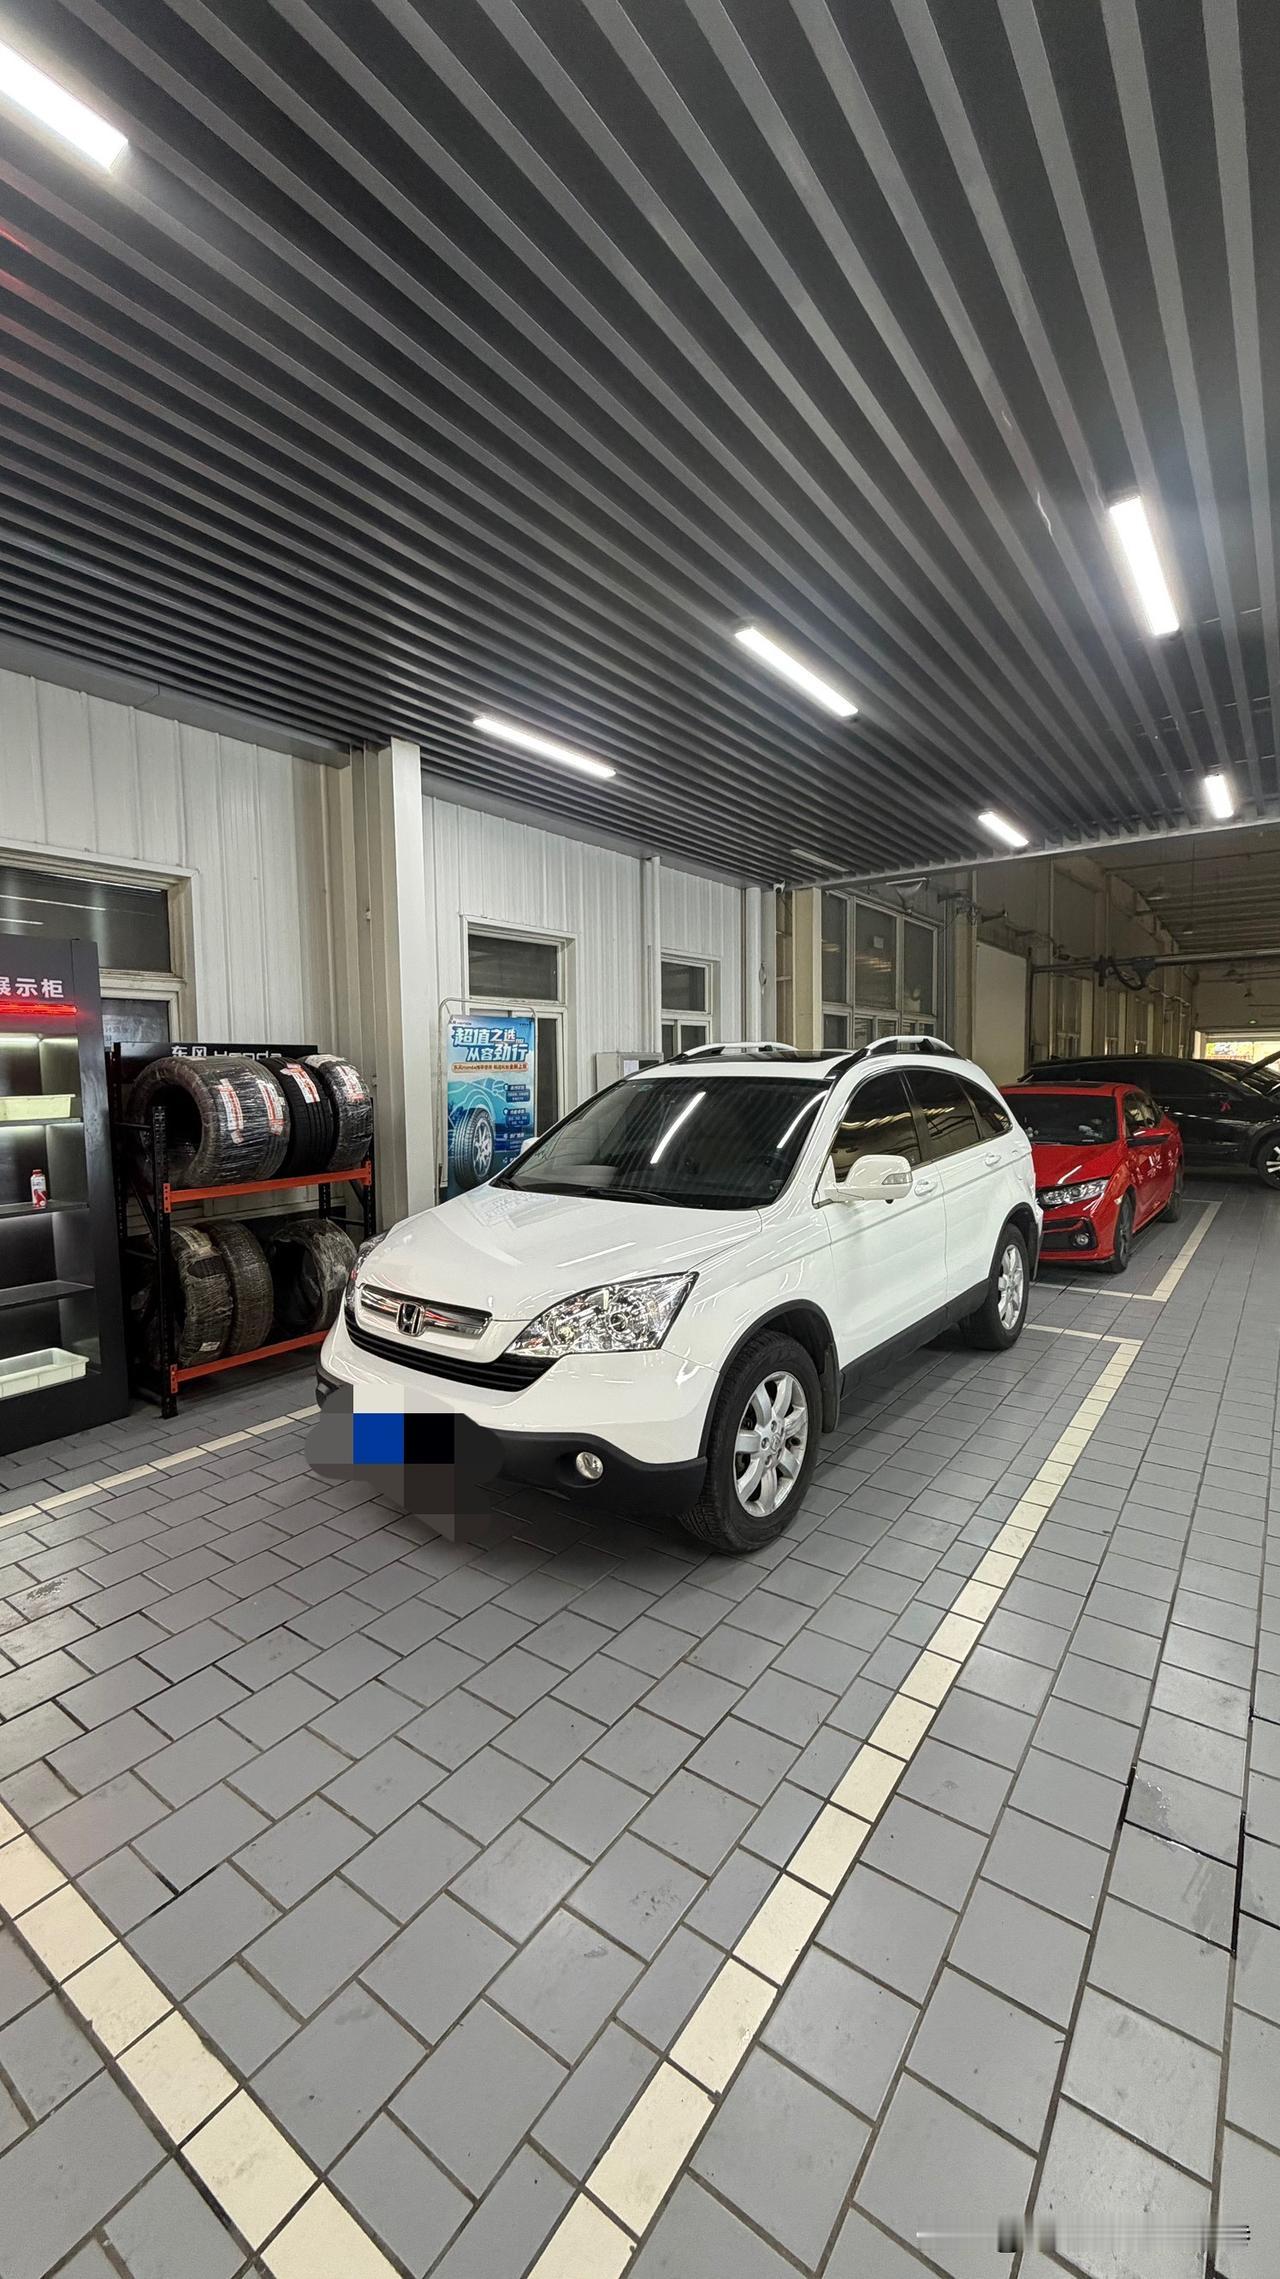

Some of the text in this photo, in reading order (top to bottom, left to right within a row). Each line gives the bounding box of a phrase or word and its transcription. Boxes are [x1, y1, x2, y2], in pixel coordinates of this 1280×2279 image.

[454, 1027, 516, 1046] 超值之选
[467, 1043, 528, 1061] 从容劲行
